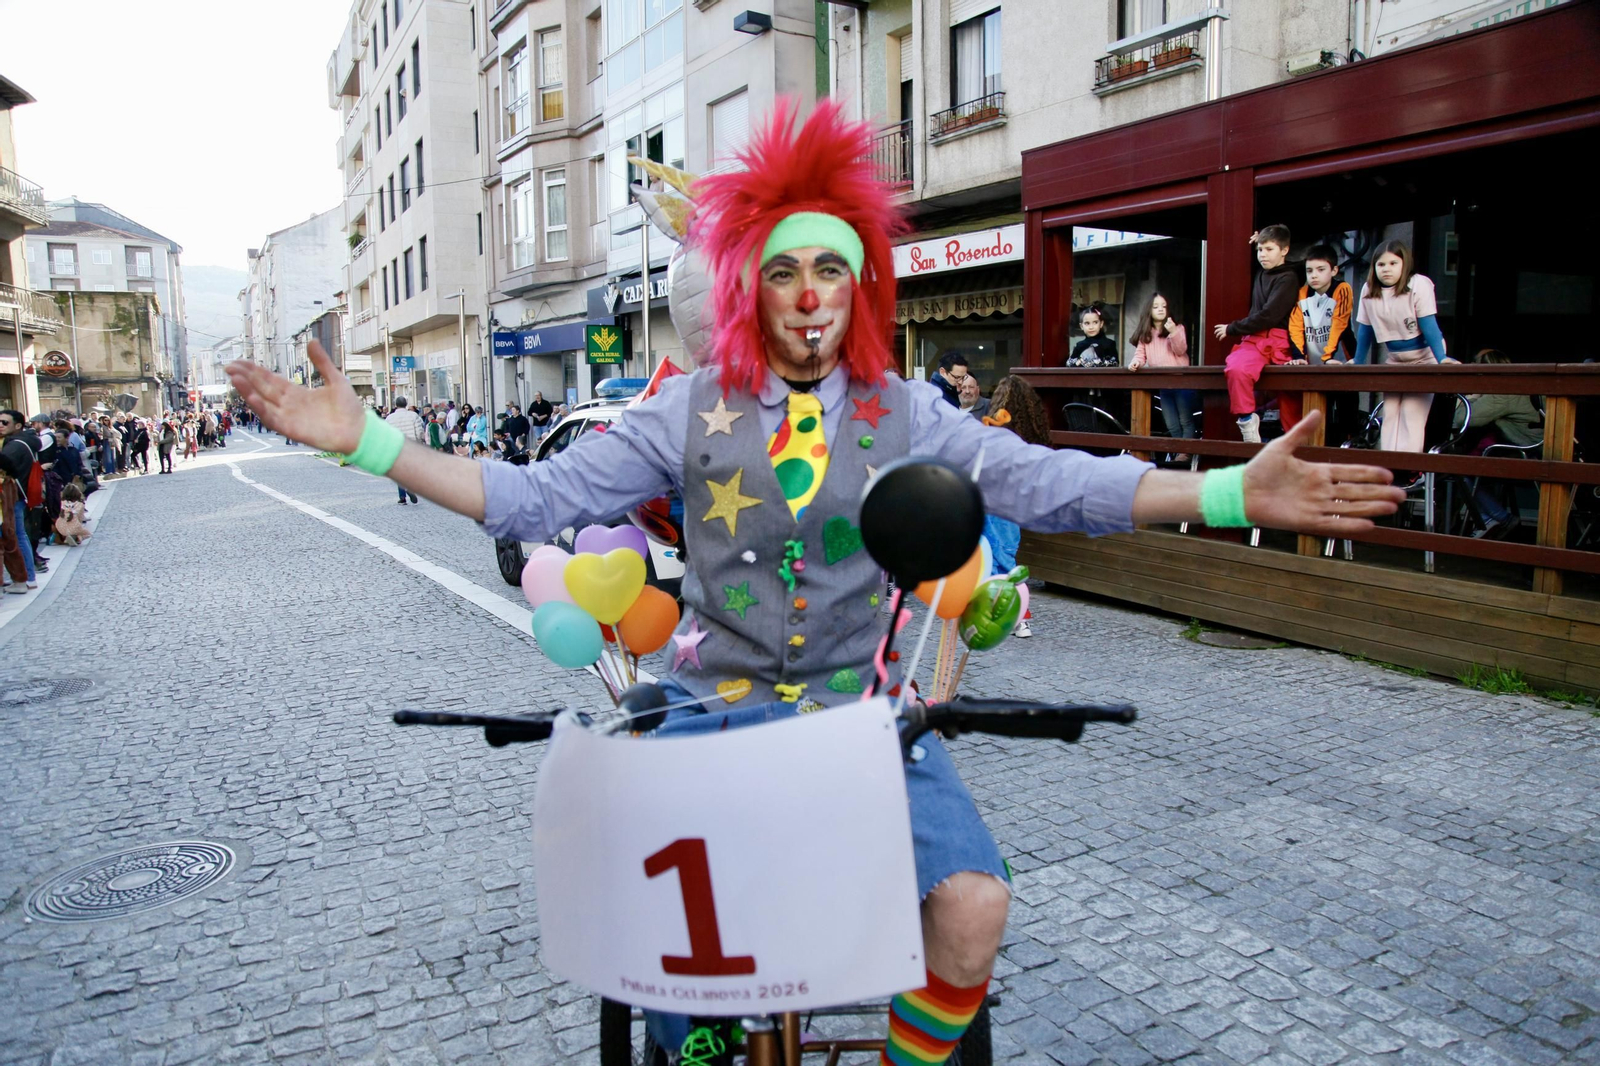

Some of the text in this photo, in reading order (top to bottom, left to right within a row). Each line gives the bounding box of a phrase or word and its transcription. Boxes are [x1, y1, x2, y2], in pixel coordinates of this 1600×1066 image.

[910, 232, 1013, 273] San Rosendo
[922, 301, 944, 315] SAN
[954, 294, 1008, 312] ROSENDO
[495, 340, 514, 348] BBVA
[524, 333, 541, 349] BBVA
[643, 838, 756, 976] 1
[757, 980, 810, 1000] 2026
